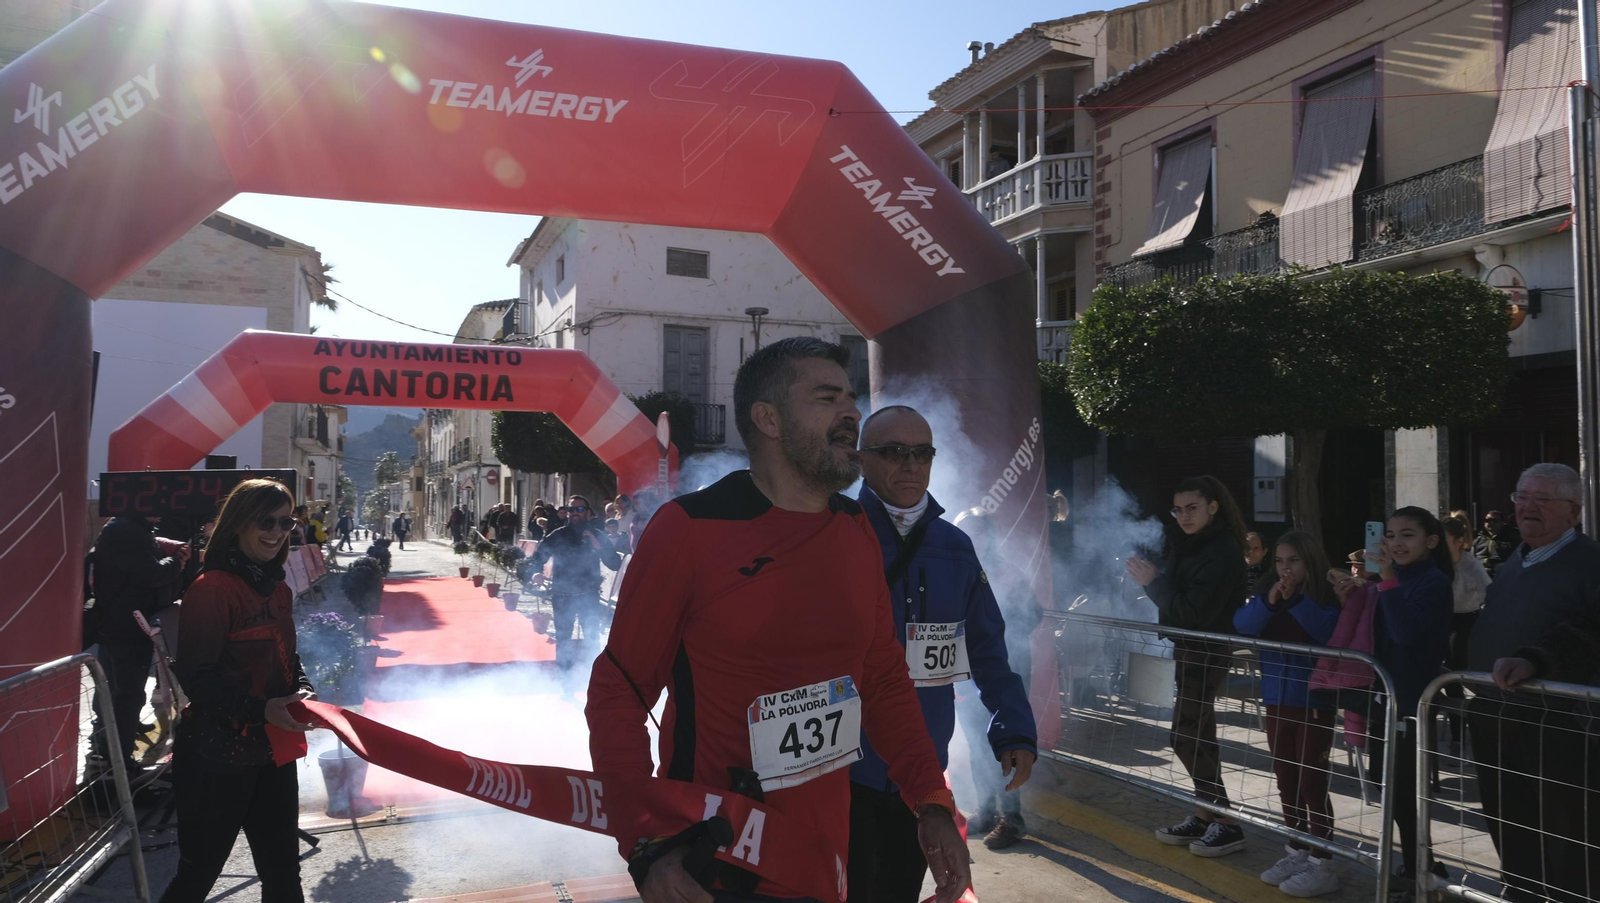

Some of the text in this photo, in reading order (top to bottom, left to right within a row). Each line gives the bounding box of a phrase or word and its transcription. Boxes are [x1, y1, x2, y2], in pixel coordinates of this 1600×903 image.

[428, 78, 629, 123] TEAMERGY
[0, 63, 160, 205] EAMERGY
[829, 144, 966, 277] TEAMERGY
[314, 339, 522, 366] AYUNTAMIENTO
[319, 365, 514, 402] CANTORIA
[981, 417, 1041, 513] amergy.es
[924, 643, 956, 670] 503
[761, 698, 828, 721] LA PÓLVORA
[764, 688, 808, 707] IV CxM
[779, 710, 843, 758] 437
[461, 755, 532, 809] TRAIL
[566, 776, 608, 830] DE
